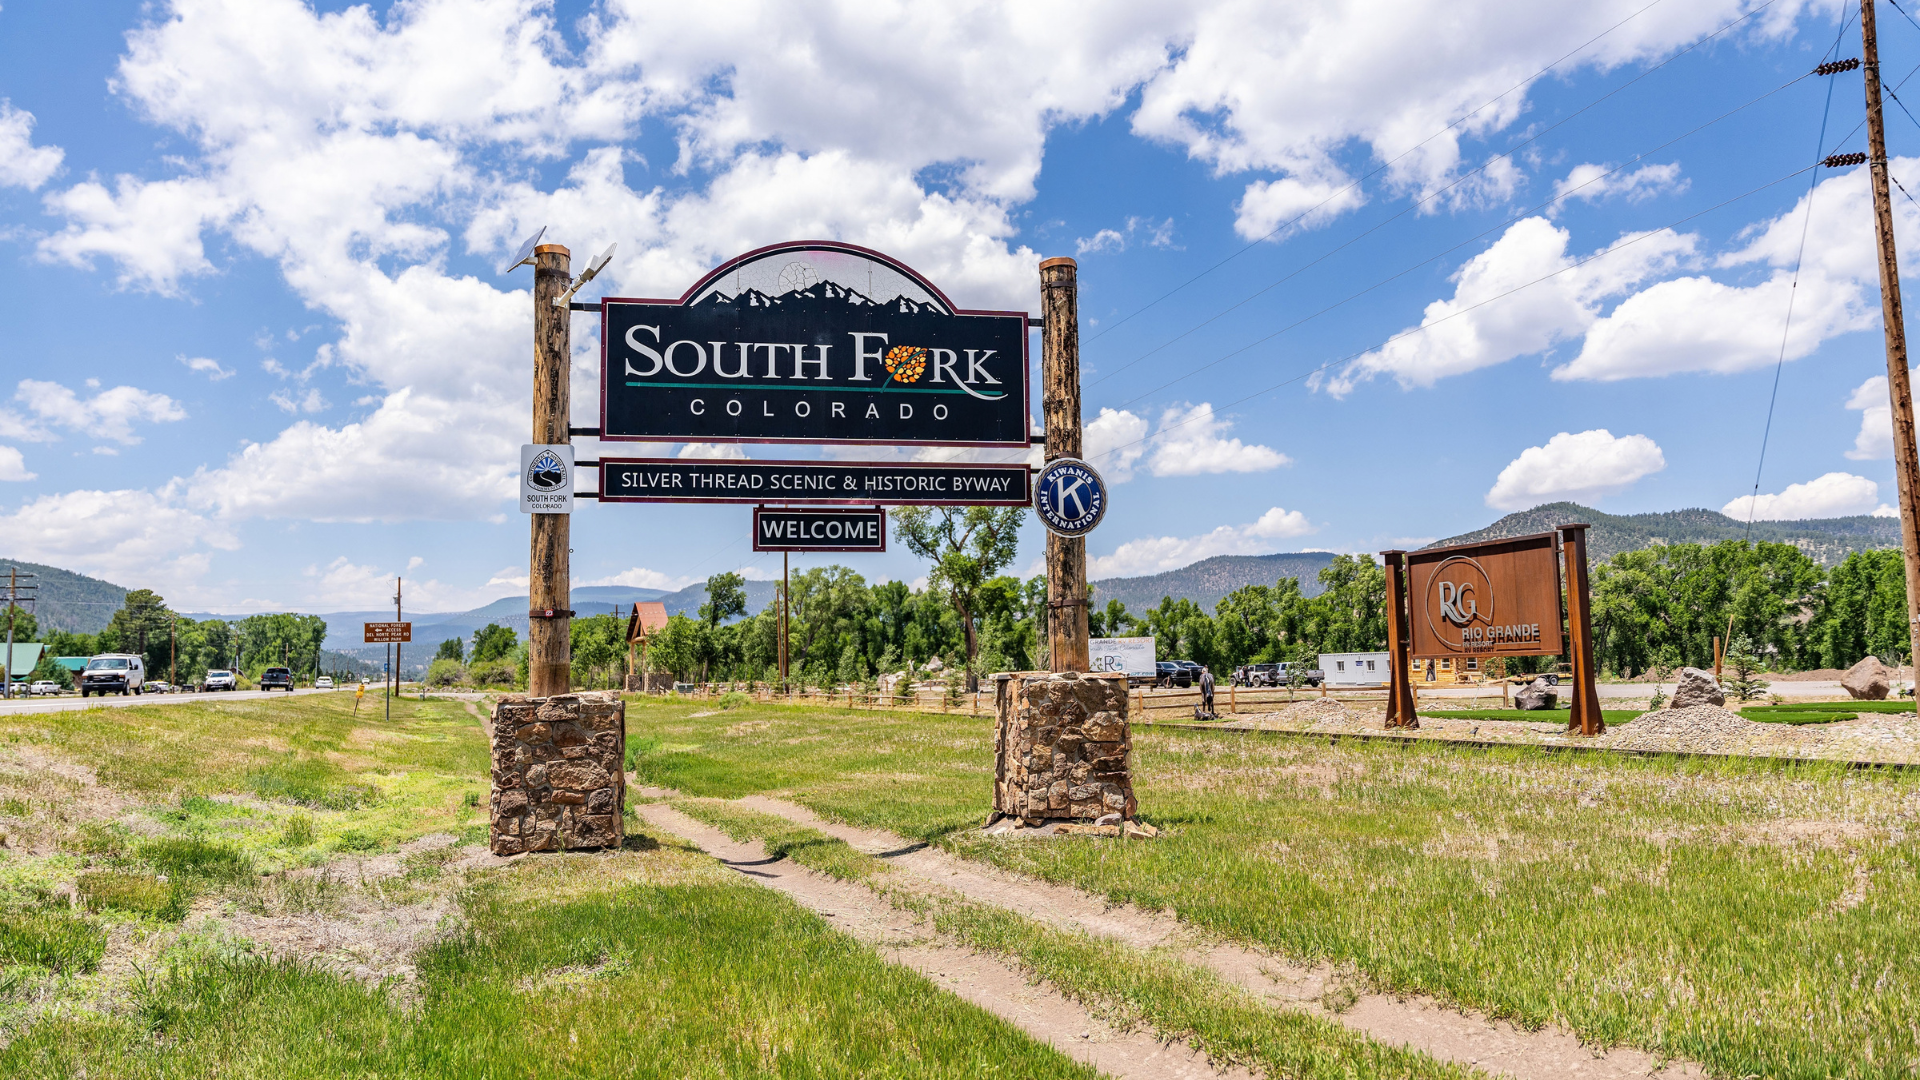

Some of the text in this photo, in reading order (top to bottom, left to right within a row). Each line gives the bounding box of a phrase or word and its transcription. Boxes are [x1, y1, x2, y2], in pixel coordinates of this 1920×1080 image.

[625, 324, 834, 380] SOUTH
[690, 398, 949, 421] COLORADO
[621, 472, 1012, 492] SILVER THREAD SCENIC & HISTORIC BYWAY
[1047, 467, 1094, 485] KIWANIS
[526, 494, 568, 503] SOUTH FORK
[1055, 475, 1088, 520] K
[1040, 490, 1100, 530] INTERNATIONAL
[761, 520, 878, 539] WELCOME
[1438, 580, 1477, 623] RG
[1462, 623, 1540, 640] RIO GRANDE
